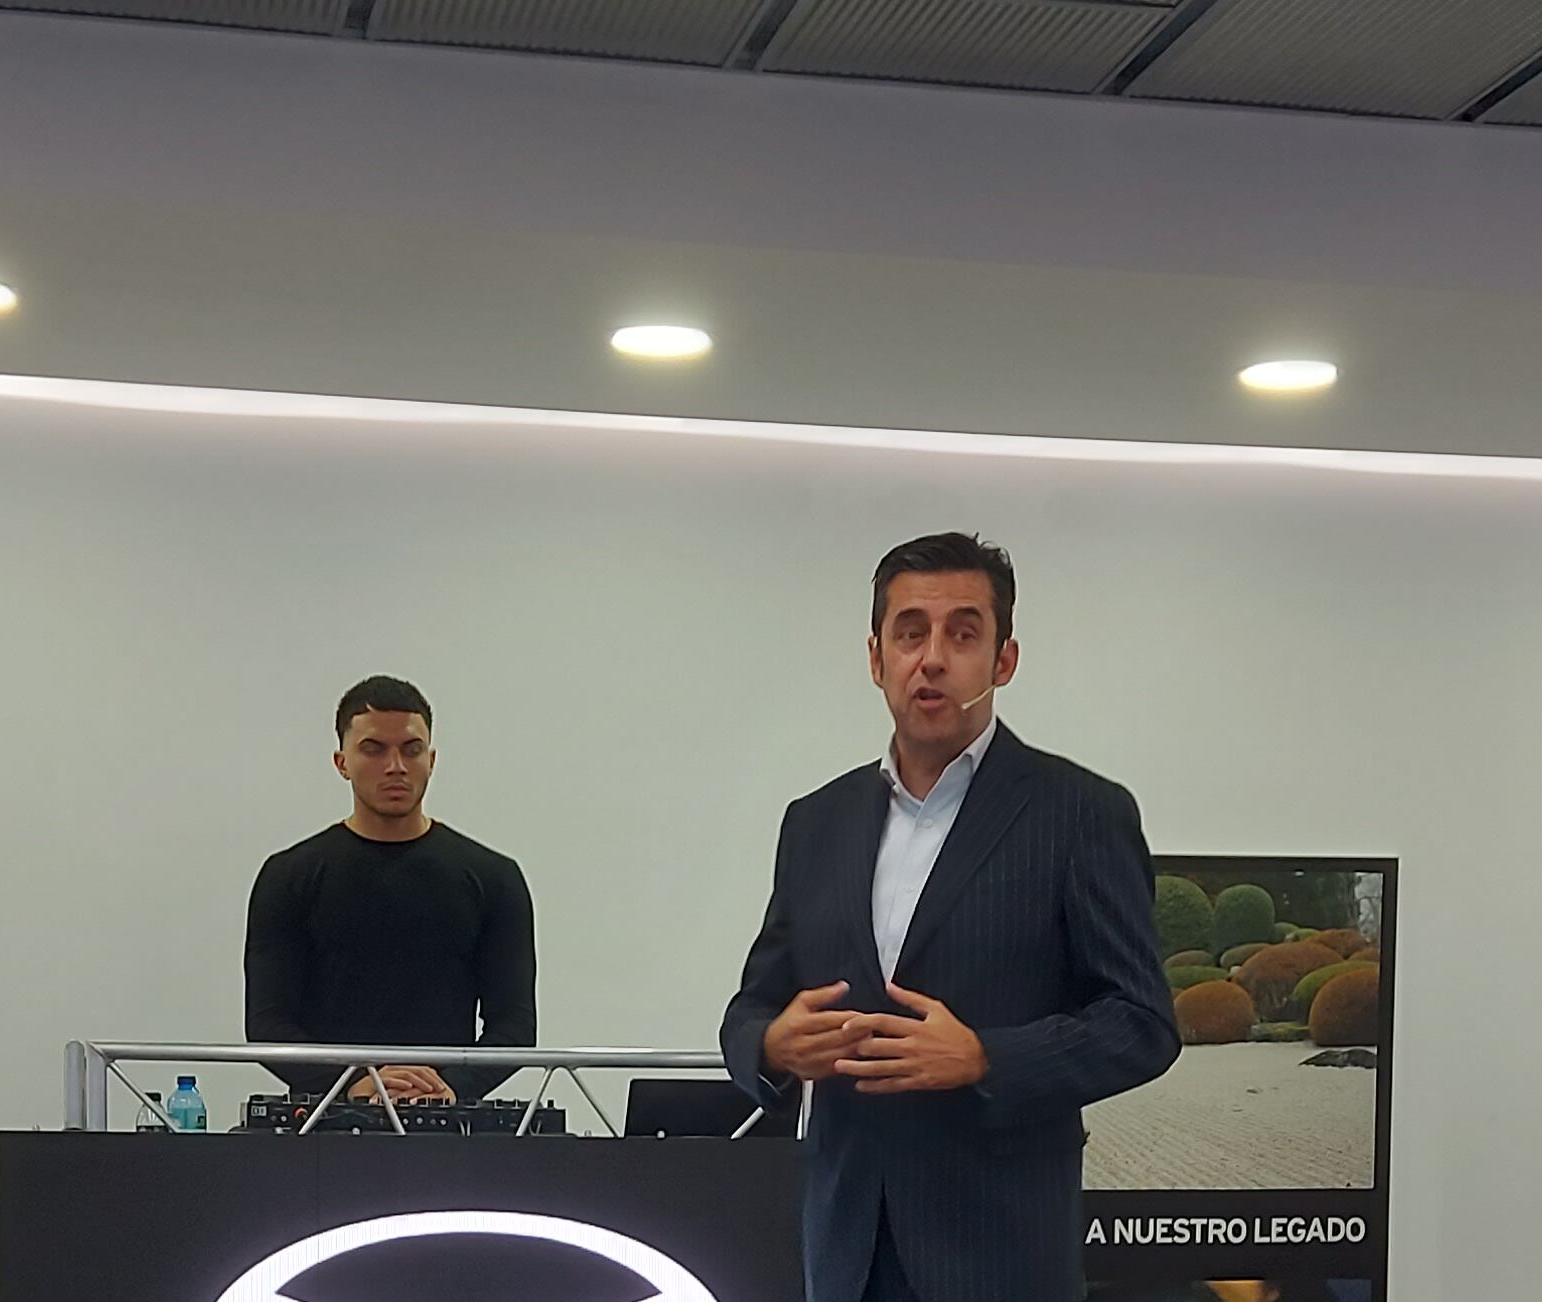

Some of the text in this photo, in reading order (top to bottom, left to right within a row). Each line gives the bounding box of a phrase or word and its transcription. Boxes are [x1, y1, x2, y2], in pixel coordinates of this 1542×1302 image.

[1084, 1216, 1367, 1245] A NUESTRO LEGADO
